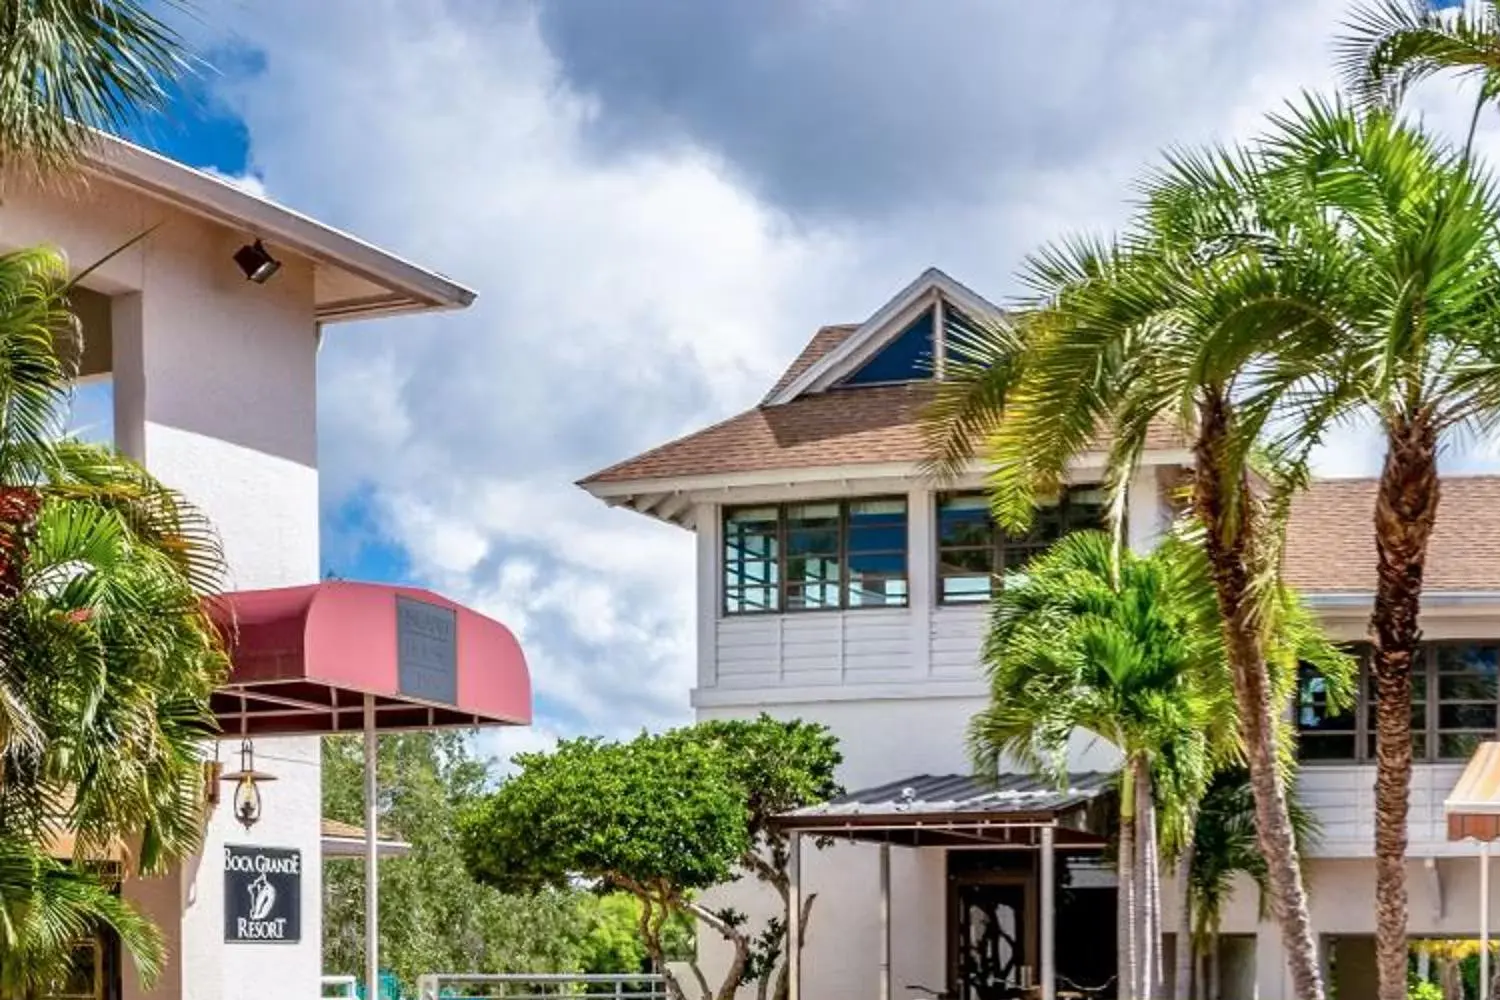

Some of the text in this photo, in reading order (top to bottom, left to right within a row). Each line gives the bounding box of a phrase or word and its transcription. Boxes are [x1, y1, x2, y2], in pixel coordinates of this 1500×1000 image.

[224, 848, 299, 873] BOCA GRANDE
[237, 918, 286, 938] RESORT
